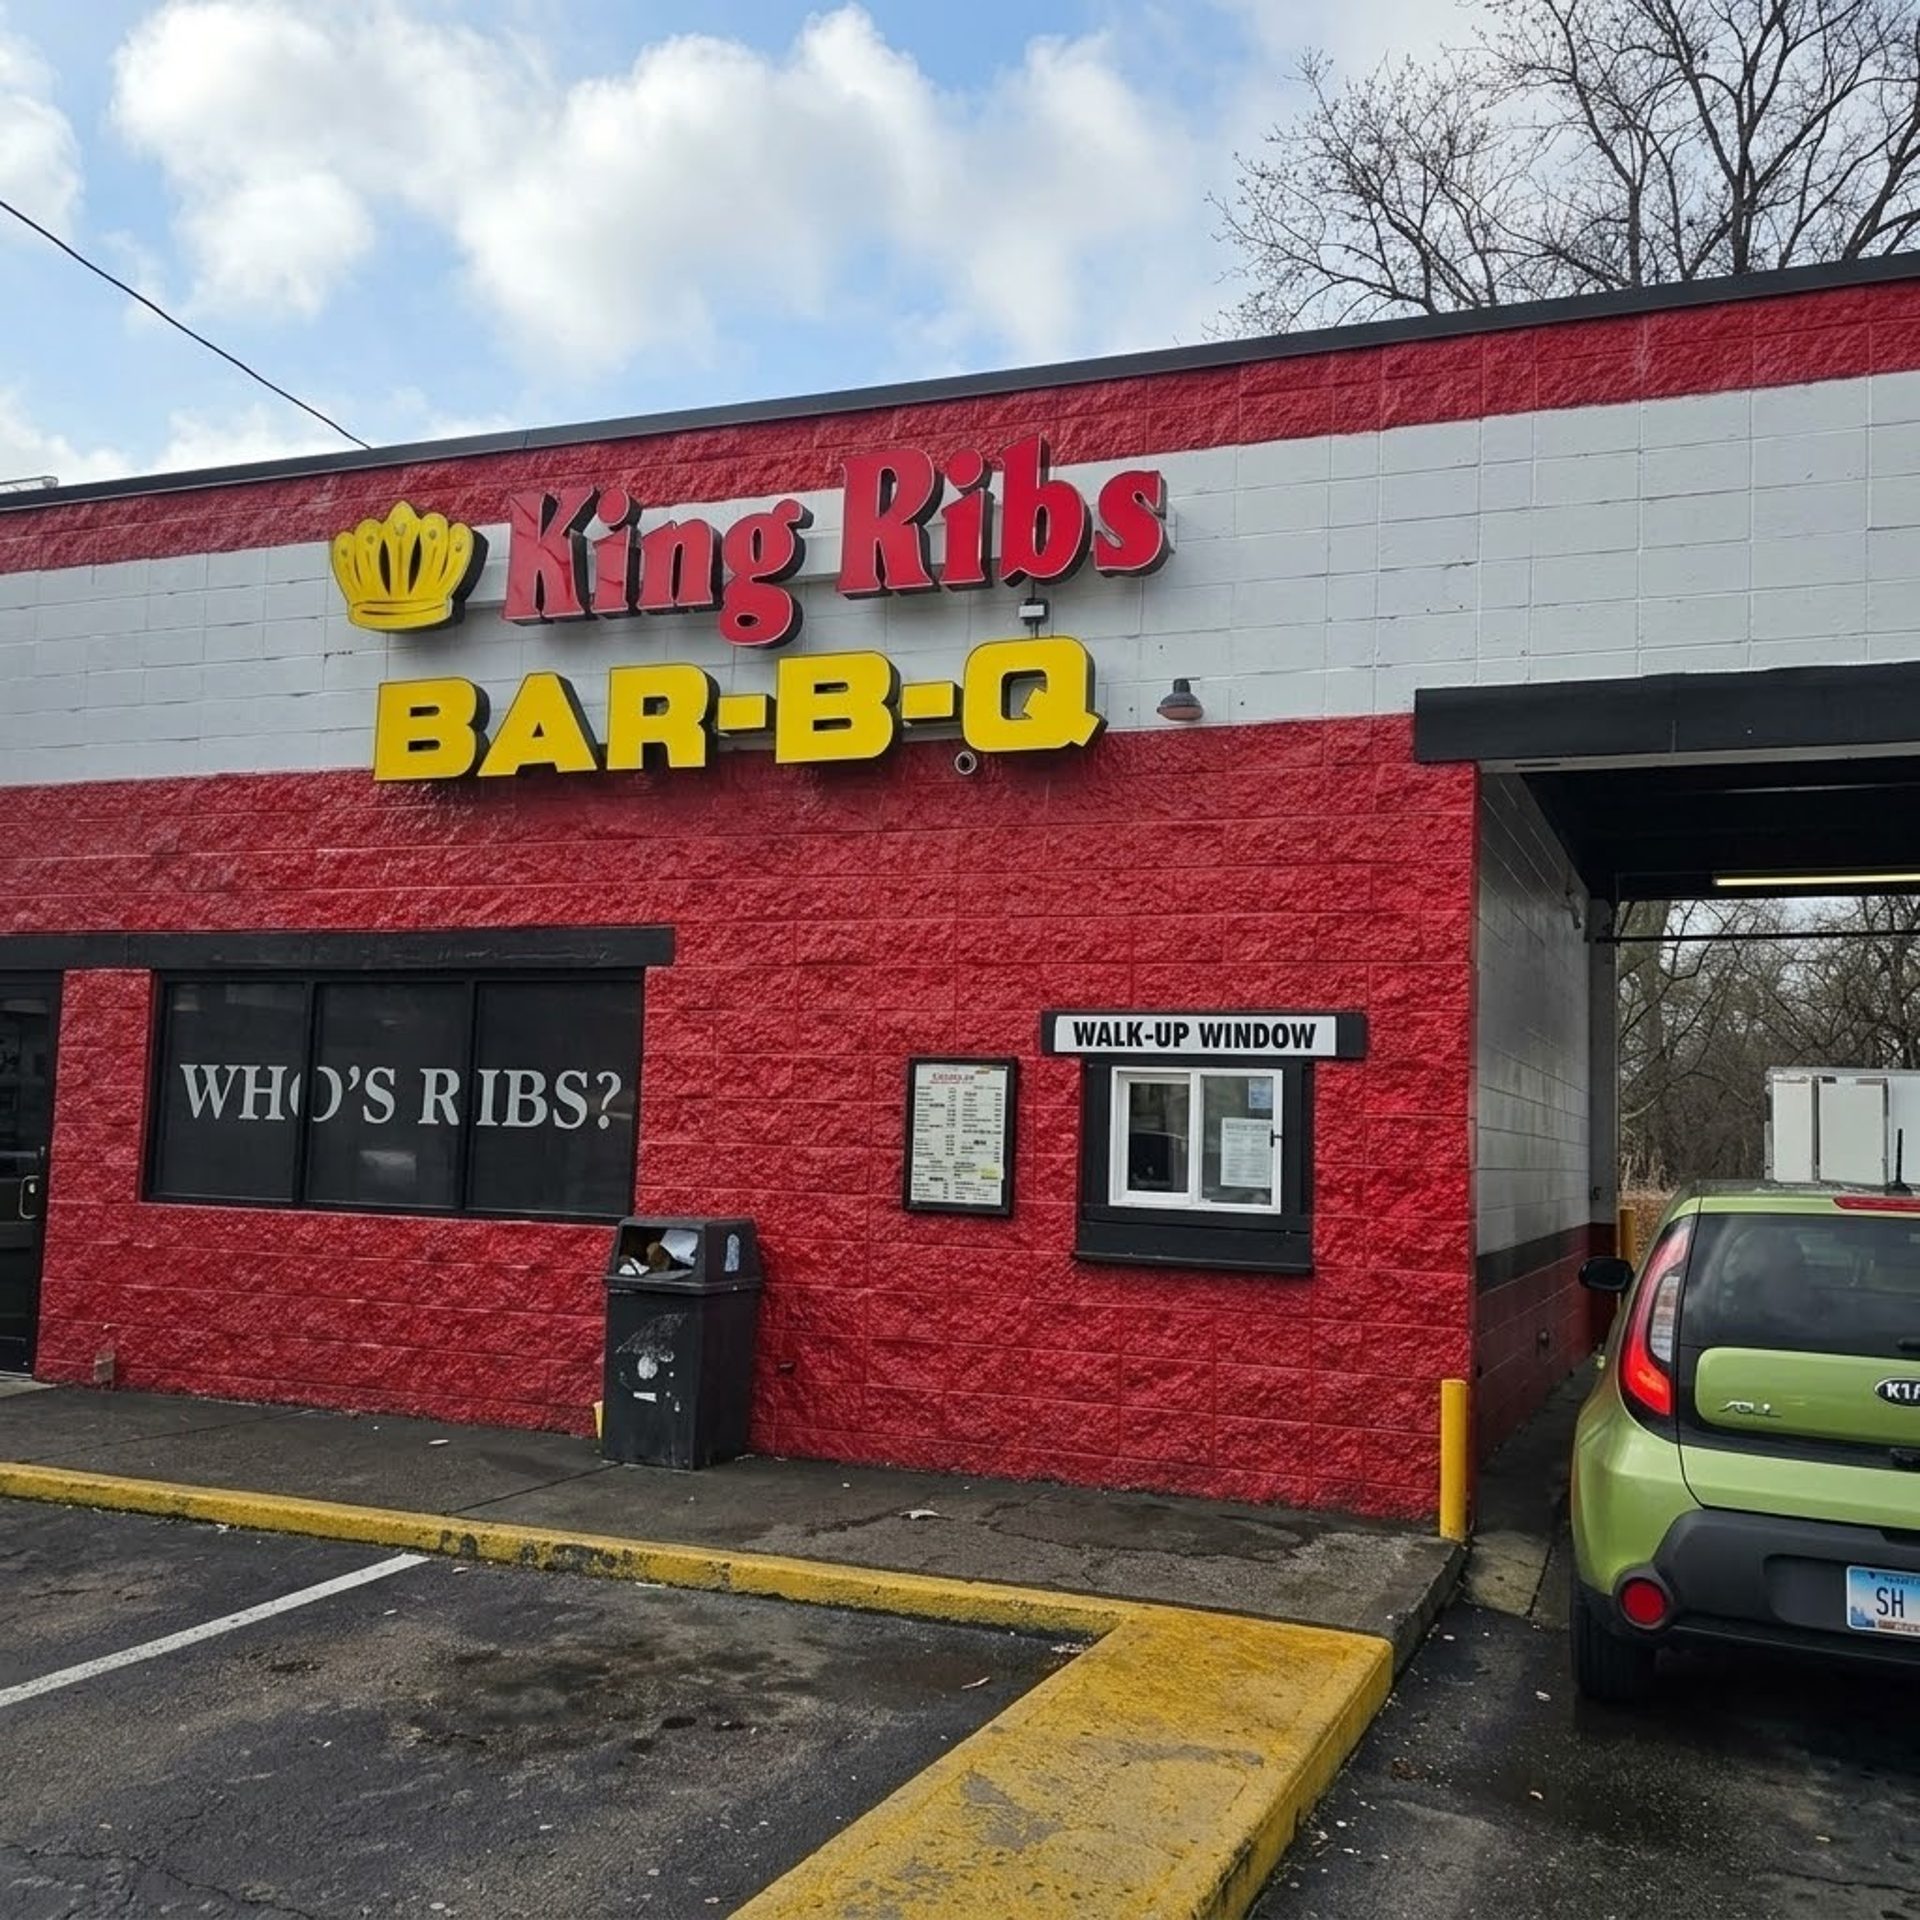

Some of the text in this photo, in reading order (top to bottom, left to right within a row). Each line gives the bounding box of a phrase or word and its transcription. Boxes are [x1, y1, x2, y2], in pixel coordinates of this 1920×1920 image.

[503, 433, 1167, 646] King Ribs
[373, 636, 1101, 781] BAR-B-Q
[1073, 1021, 1317, 1049] WALK-UP WINDOW
[417, 1067, 622, 1130] RIBS?
